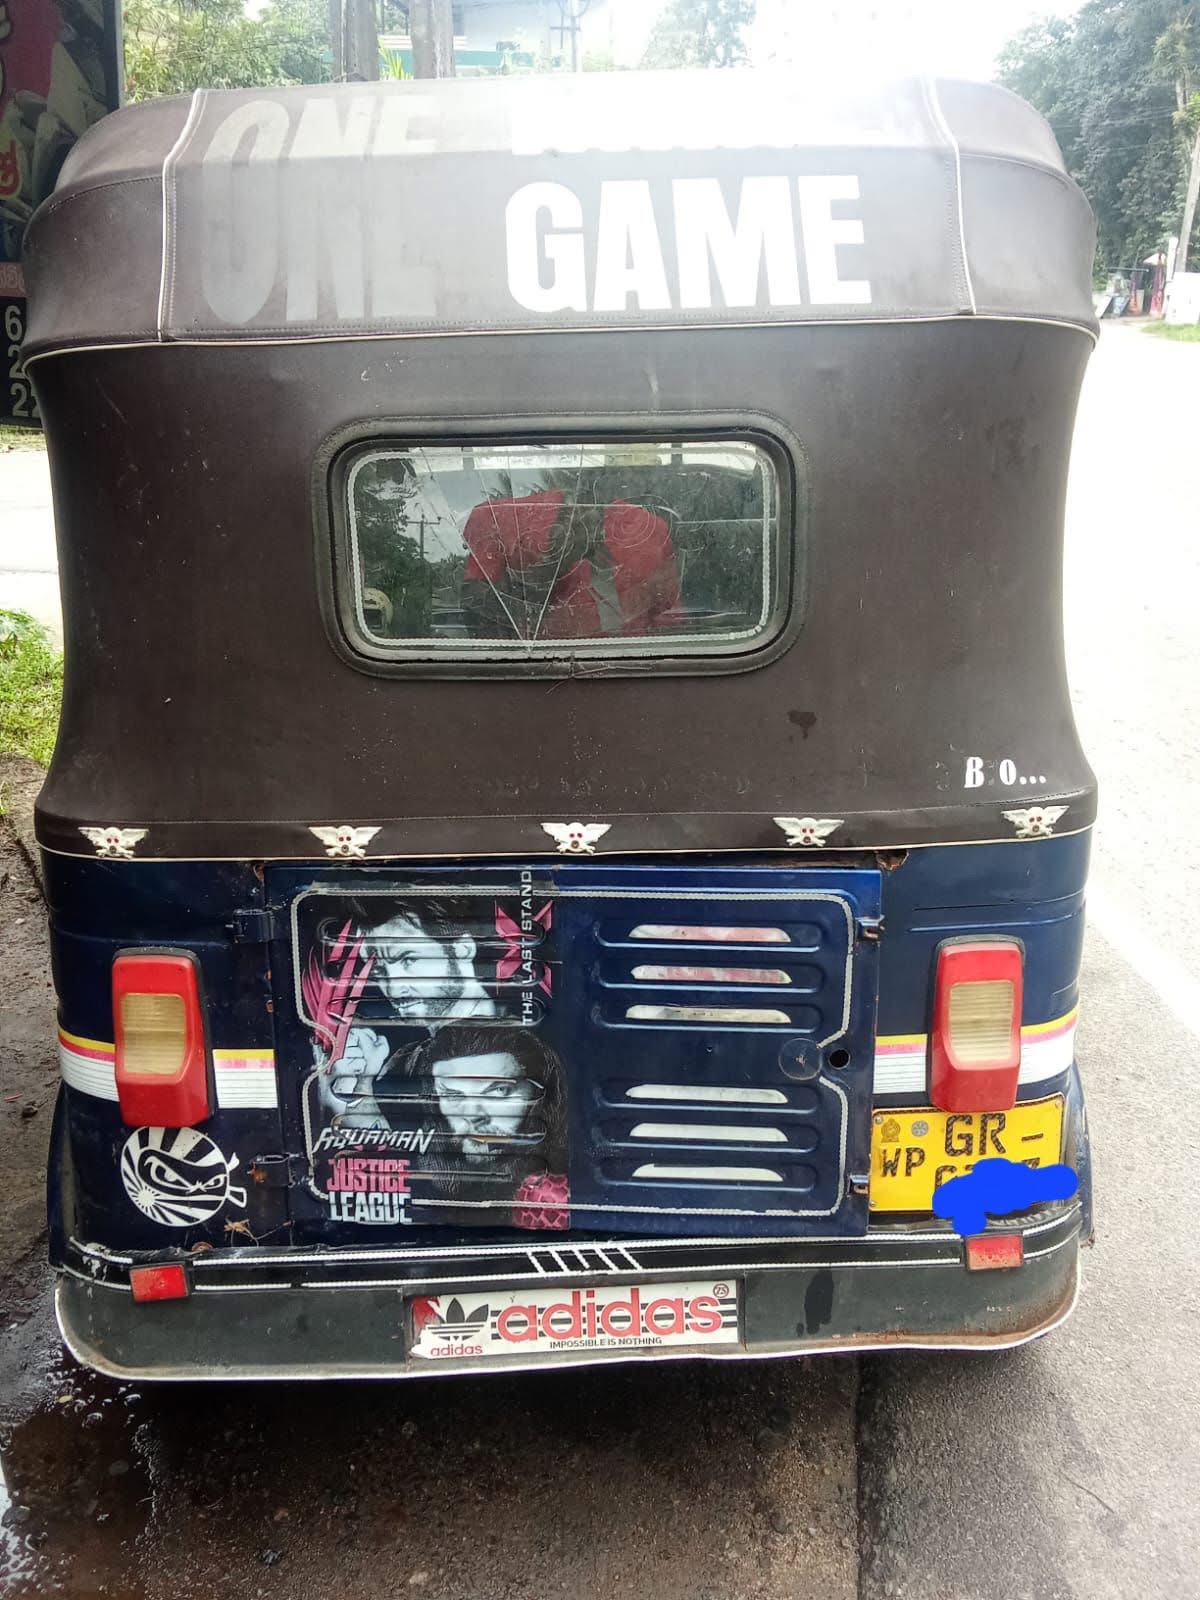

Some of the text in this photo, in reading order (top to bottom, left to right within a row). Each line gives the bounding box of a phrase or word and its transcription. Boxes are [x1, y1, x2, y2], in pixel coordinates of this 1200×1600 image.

[202, 97, 438, 324] ONE
[505, 174, 872, 313] GAME
[521, 870, 533, 1025] THE LAST STAND
[312, 1128, 436, 1155] AQUAMAN
[326, 1158, 411, 1192] JUSTICE
[881, 1147, 925, 1178] WP
[328, 1191, 412, 1223] LEAGUE
[497, 1287, 722, 1343] adidas
[430, 1343, 483, 1357] adidas
[549, 1336, 662, 1349] IMPOSSIBLE IS NOTHING
